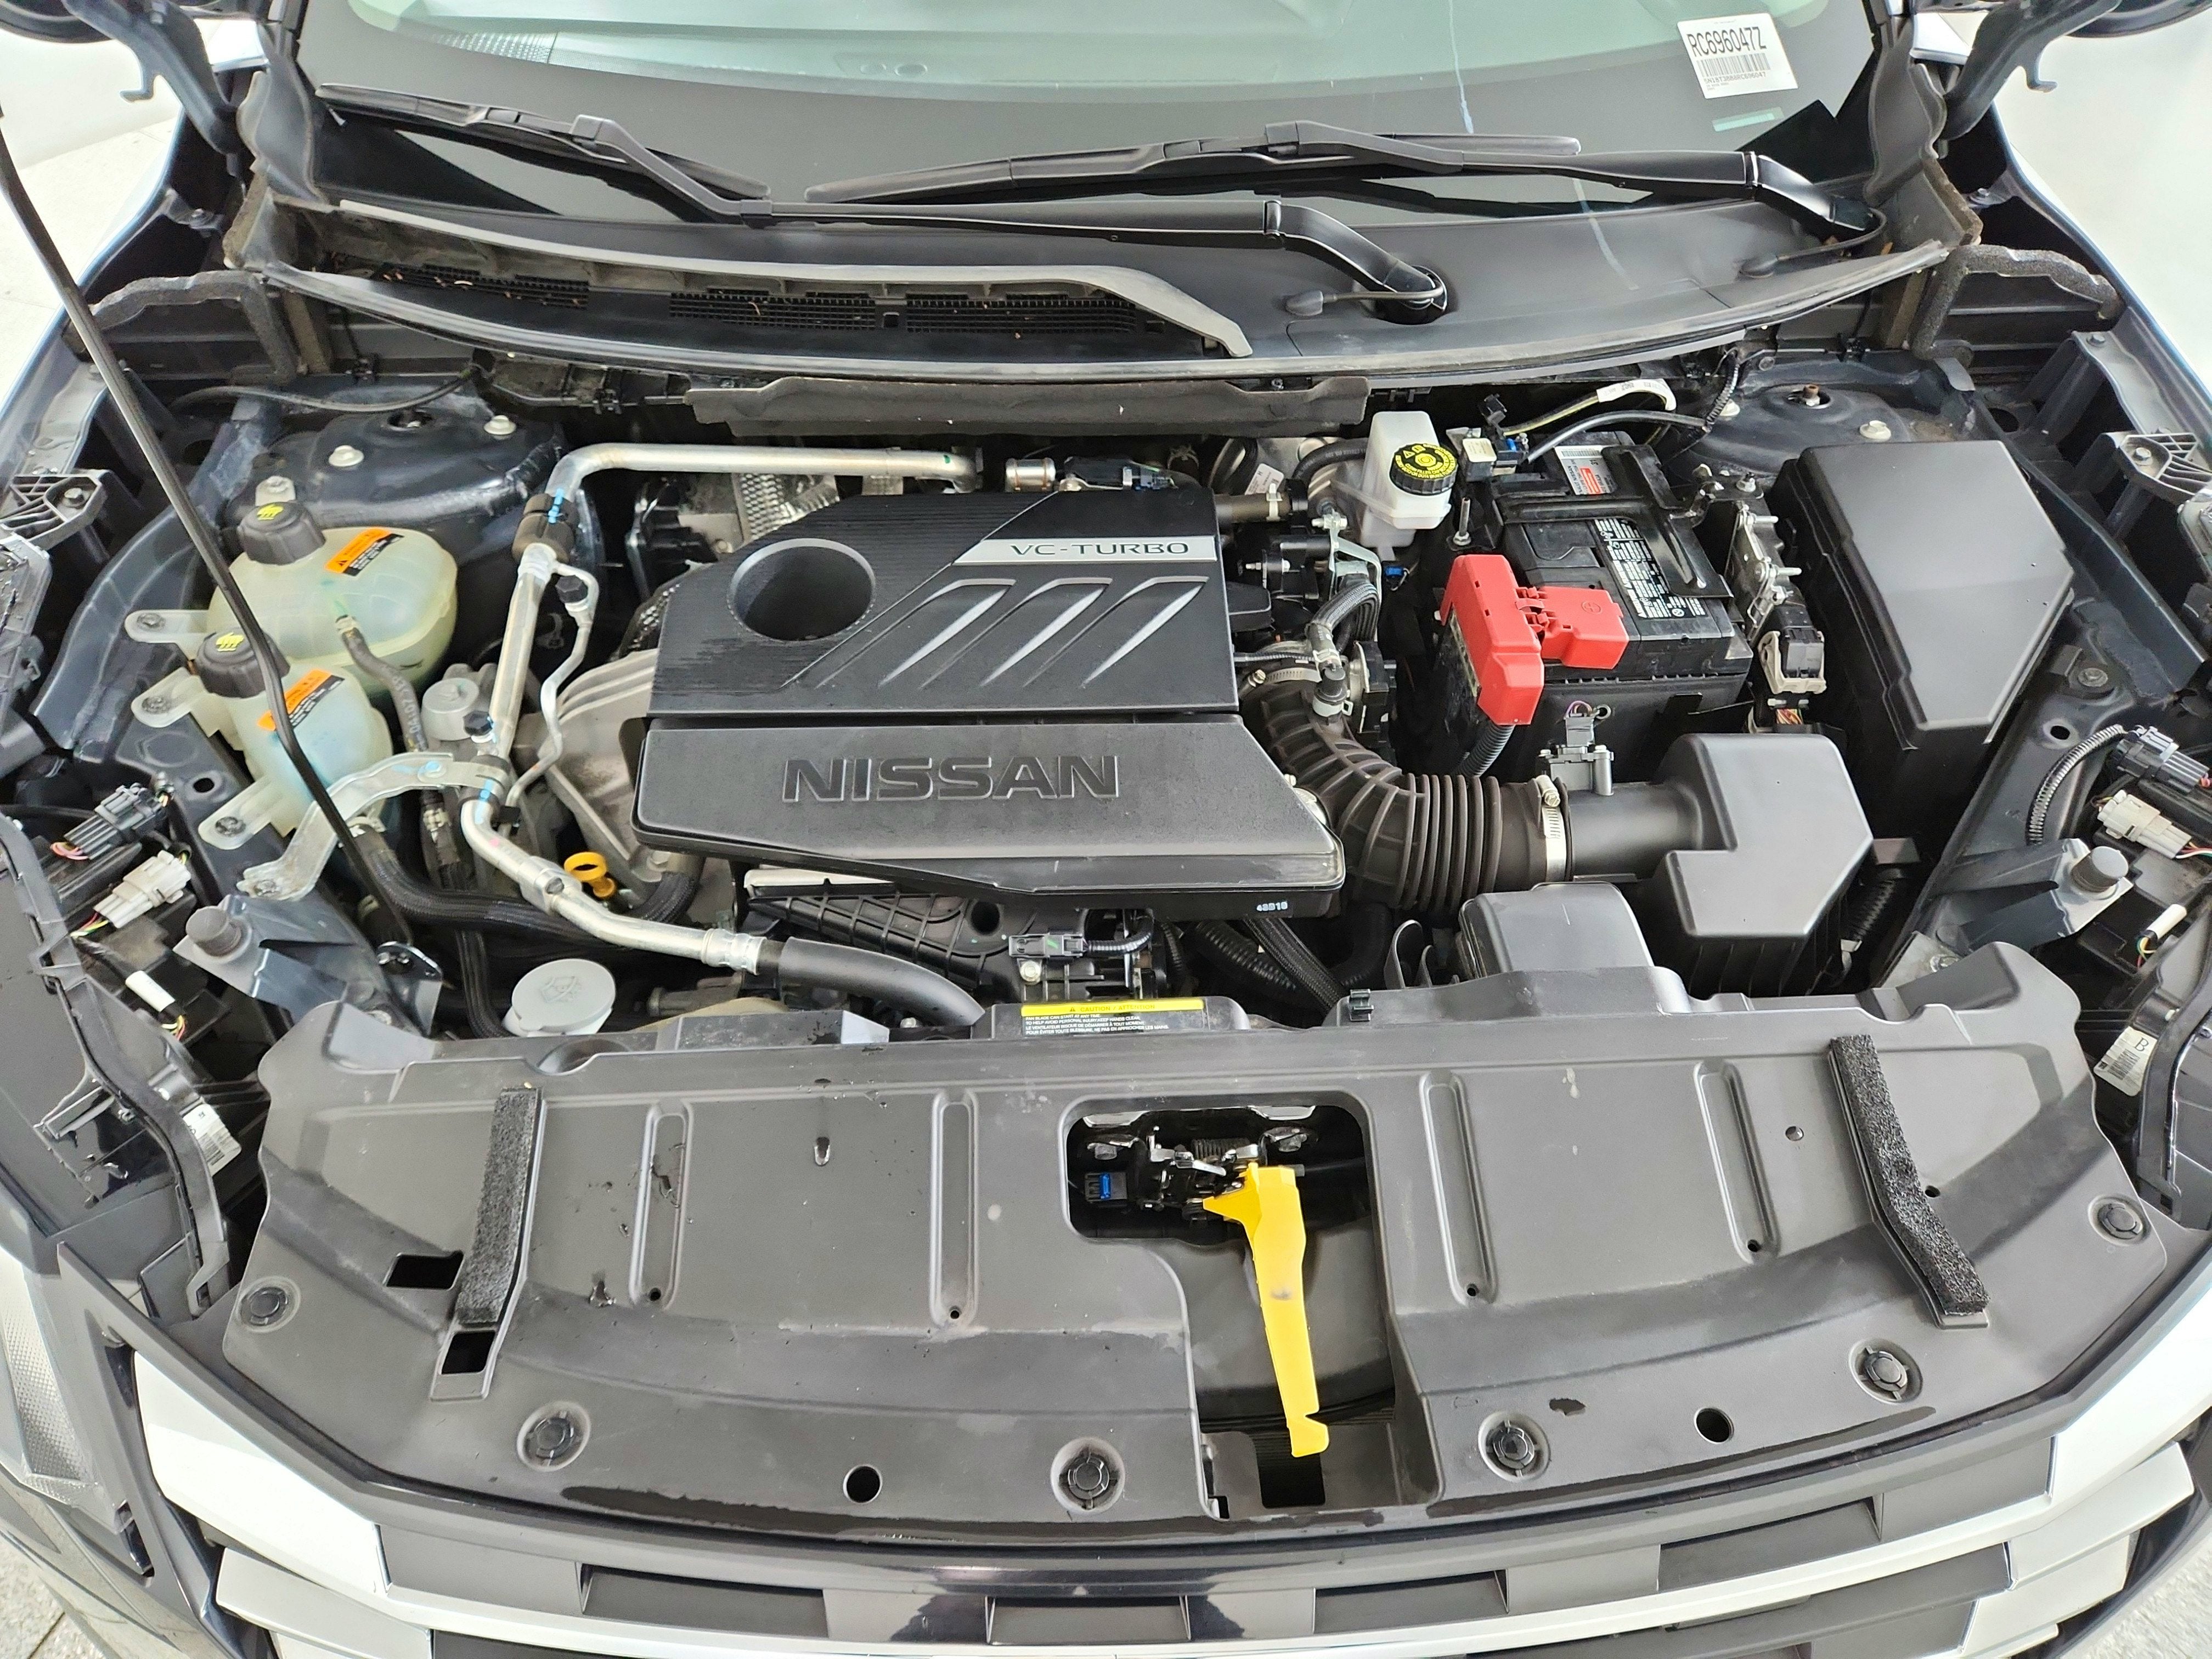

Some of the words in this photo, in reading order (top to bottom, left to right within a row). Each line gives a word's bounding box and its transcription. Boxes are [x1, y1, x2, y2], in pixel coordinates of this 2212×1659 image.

[1686, 26, 1767, 57] RC696047Z
[1011, 543, 1189, 555] VC-TURBO
[782, 755, 1120, 802] NISSAN
[2134, 1037, 2149, 1052] B
